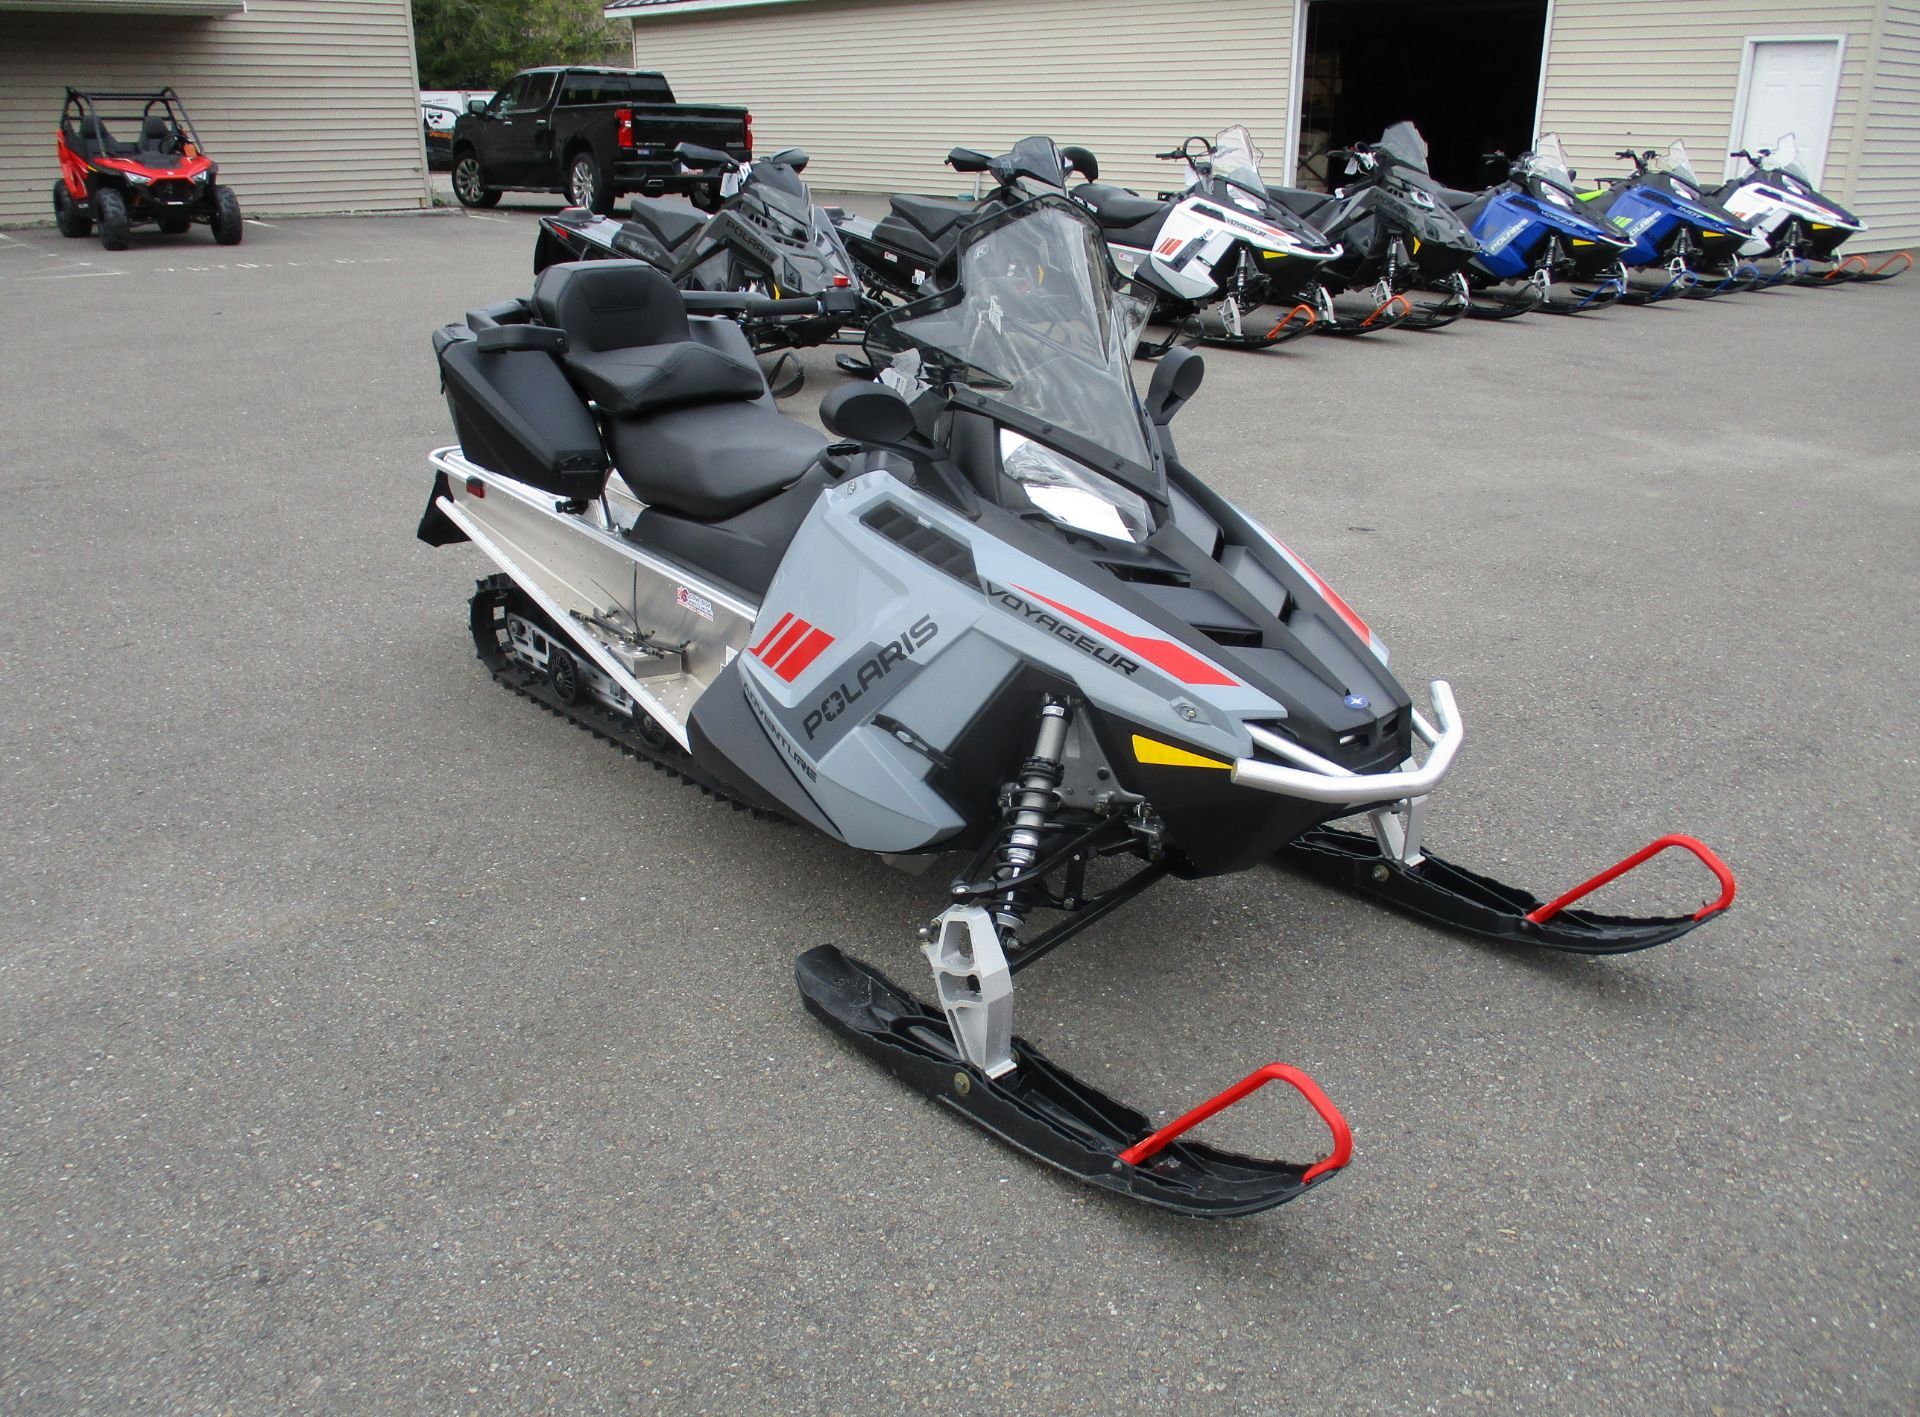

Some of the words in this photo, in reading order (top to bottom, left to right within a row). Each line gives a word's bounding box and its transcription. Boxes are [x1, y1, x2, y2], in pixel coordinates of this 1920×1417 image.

[1226, 218, 1267, 238] VOYAGEUR
[1676, 206, 1704, 219] INDY
[726, 220, 778, 263] POLARIS
[1490, 217, 1529, 252] POLARIS
[987, 581, 1140, 676] VOYAGEUR
[802, 614, 939, 740] POLARIS
[743, 682, 818, 783] ADVENTURE
